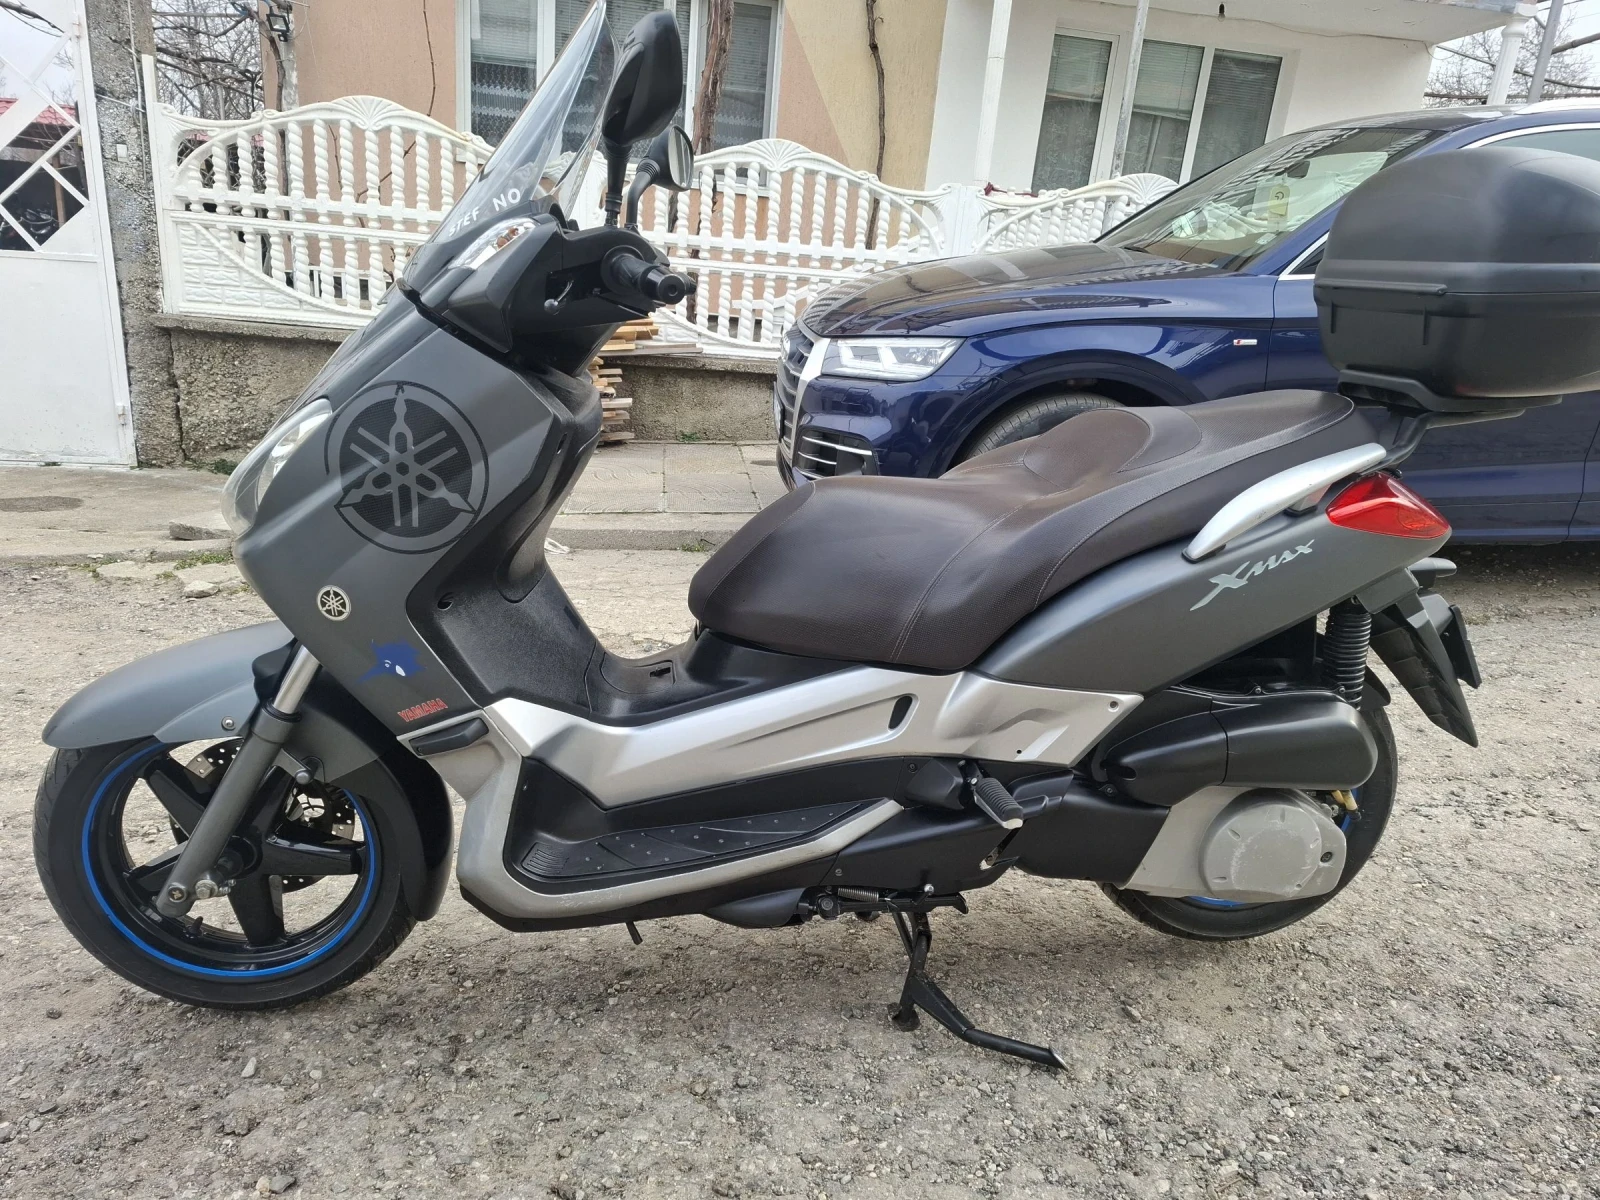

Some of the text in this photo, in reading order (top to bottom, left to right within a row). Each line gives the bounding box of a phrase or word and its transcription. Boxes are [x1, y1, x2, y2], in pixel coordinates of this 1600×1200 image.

[448, 188, 521, 237] STEF NO
[397, 698, 449, 722] YAMAHA
